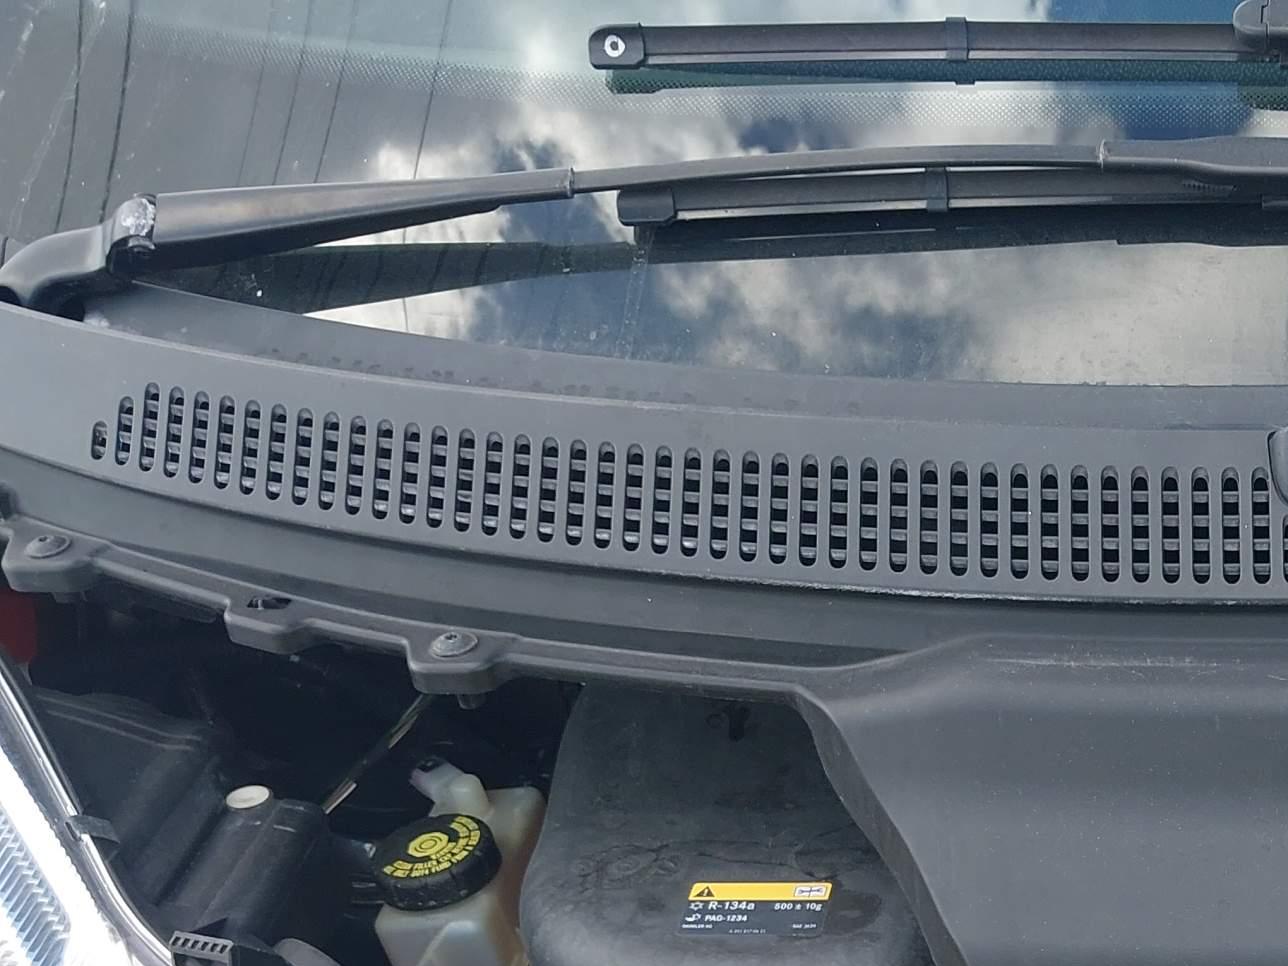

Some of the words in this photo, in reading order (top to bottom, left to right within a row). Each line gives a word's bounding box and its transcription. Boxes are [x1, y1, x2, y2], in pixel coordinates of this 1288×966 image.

[707, 901, 755, 911] R-134a
[774, 902, 793, 911] 500
[805, 902, 823, 912] 10g
